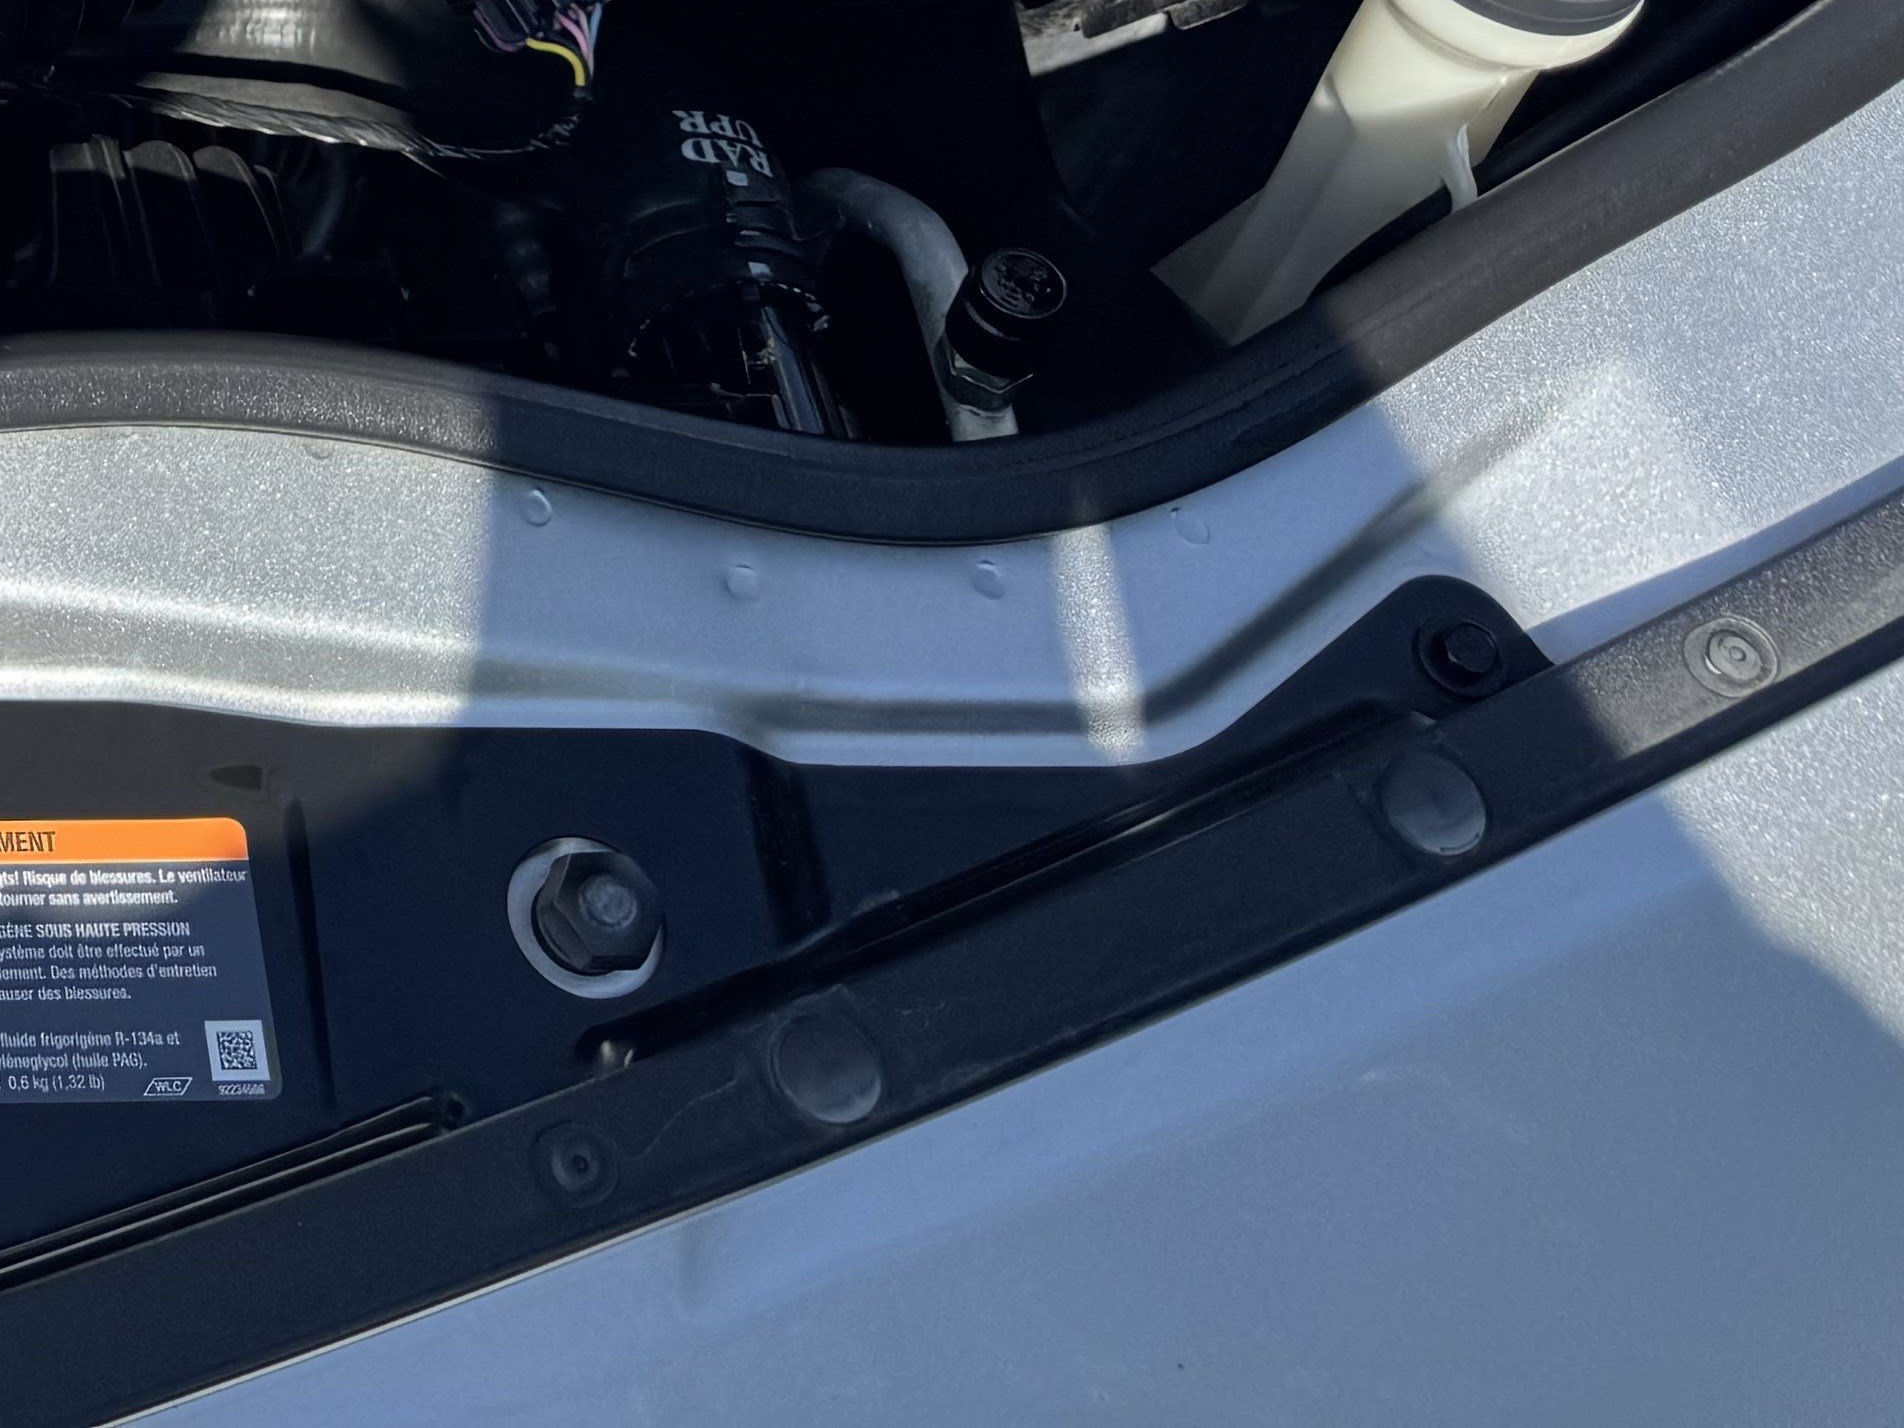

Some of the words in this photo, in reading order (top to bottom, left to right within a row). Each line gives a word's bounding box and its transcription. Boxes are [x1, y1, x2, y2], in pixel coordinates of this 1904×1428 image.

[672, 109, 765, 146] UPR
[681, 135, 772, 178] RAD
[23, 870, 66, 889] Risque
[70, 870, 86, 885] de
[90, 869, 155, 885] blessures.
[159, 868, 174, 883] Le
[178, 867, 247, 883] ventilateur
[0, 891, 45, 907] tourner
[49, 893, 80, 905] sans
[84, 889, 177, 905] avertissement.
[37, 924, 71, 939] SOUS
[76, 923, 120, 938] HAUTE
[124, 922, 190, 937] PRESSION
[49, 944, 74, 958] doit
[77, 944, 102, 958] être
[106, 943, 159, 958] effectué
[163, 945, 184, 961] par
[188, 945, 204, 957] un
[51, 966, 75, 979] Des
[79, 964, 143, 979] méthodes
[38, 986, 61, 999] des
[65, 985, 130, 1000] blessures.
[0, 1033, 36, 1047] fluide
[40, 1032, 111, 1050] frigorigène
[115, 1032, 162, 1046] R-134a
[167, 1032, 181, 1045] et
[72, 1053, 108, 1070] (huile
[113, 1052, 147, 1069] PAG).
[33, 1075, 49, 1092] kg
[90, 1073, 105, 1091] lb)
